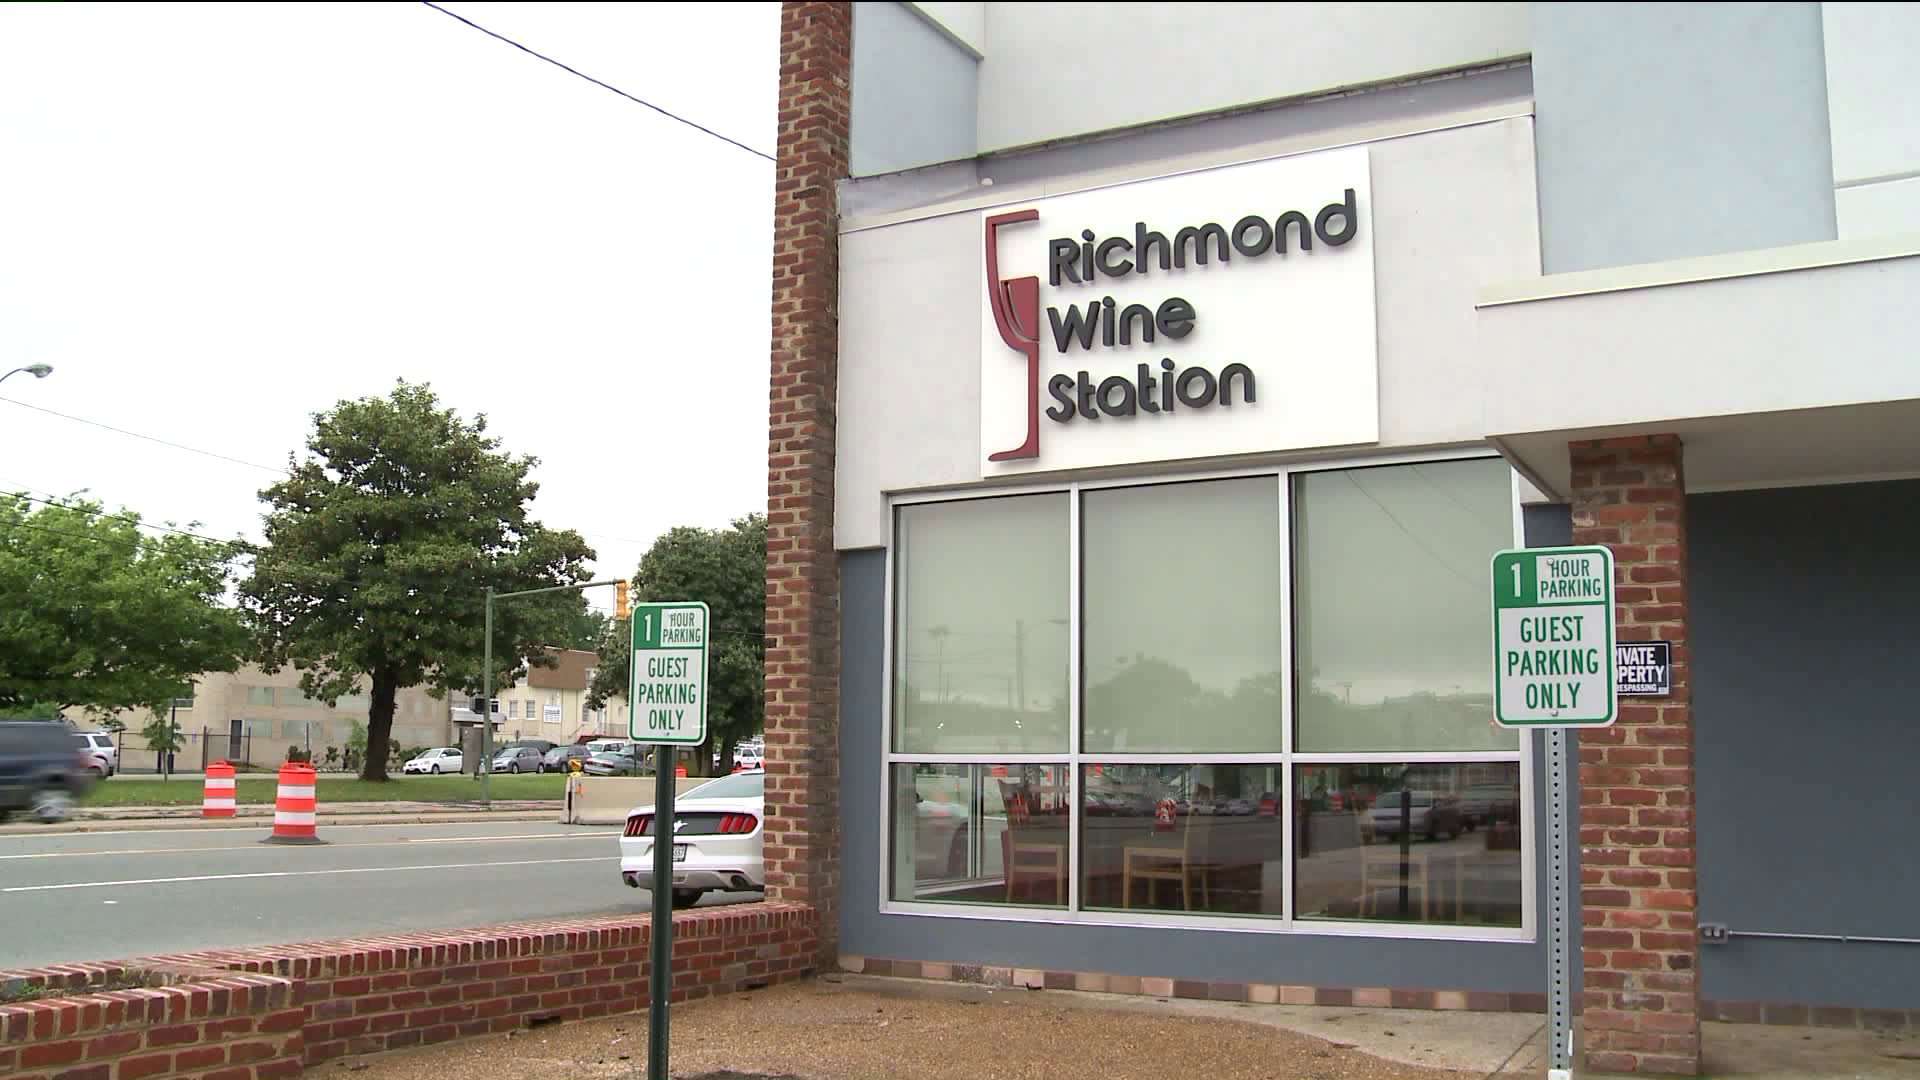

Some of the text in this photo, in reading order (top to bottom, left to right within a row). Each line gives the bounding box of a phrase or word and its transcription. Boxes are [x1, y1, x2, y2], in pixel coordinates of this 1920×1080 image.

[1049, 188, 1357, 286] Richmond
[1046, 296, 1196, 353] Wine
[1045, 357, 1256, 423] Station
[1511, 559, 1590, 597] 1 HOUR
[1540, 578, 1601, 598] PARKING
[644, 613, 695, 641] 1 HOUR
[662, 628, 701, 643] PARKING
[1520, 616, 1584, 643] GUEST
[648, 657, 688, 678] GUEST
[1507, 648, 1599, 676] PARKING
[1616, 647, 1656, 665] IVATE
[1616, 665, 1665, 683] PERTY
[638, 684, 696, 704] PARKING
[1525, 682, 1581, 709] ONLY
[649, 709, 684, 730] ONLY
